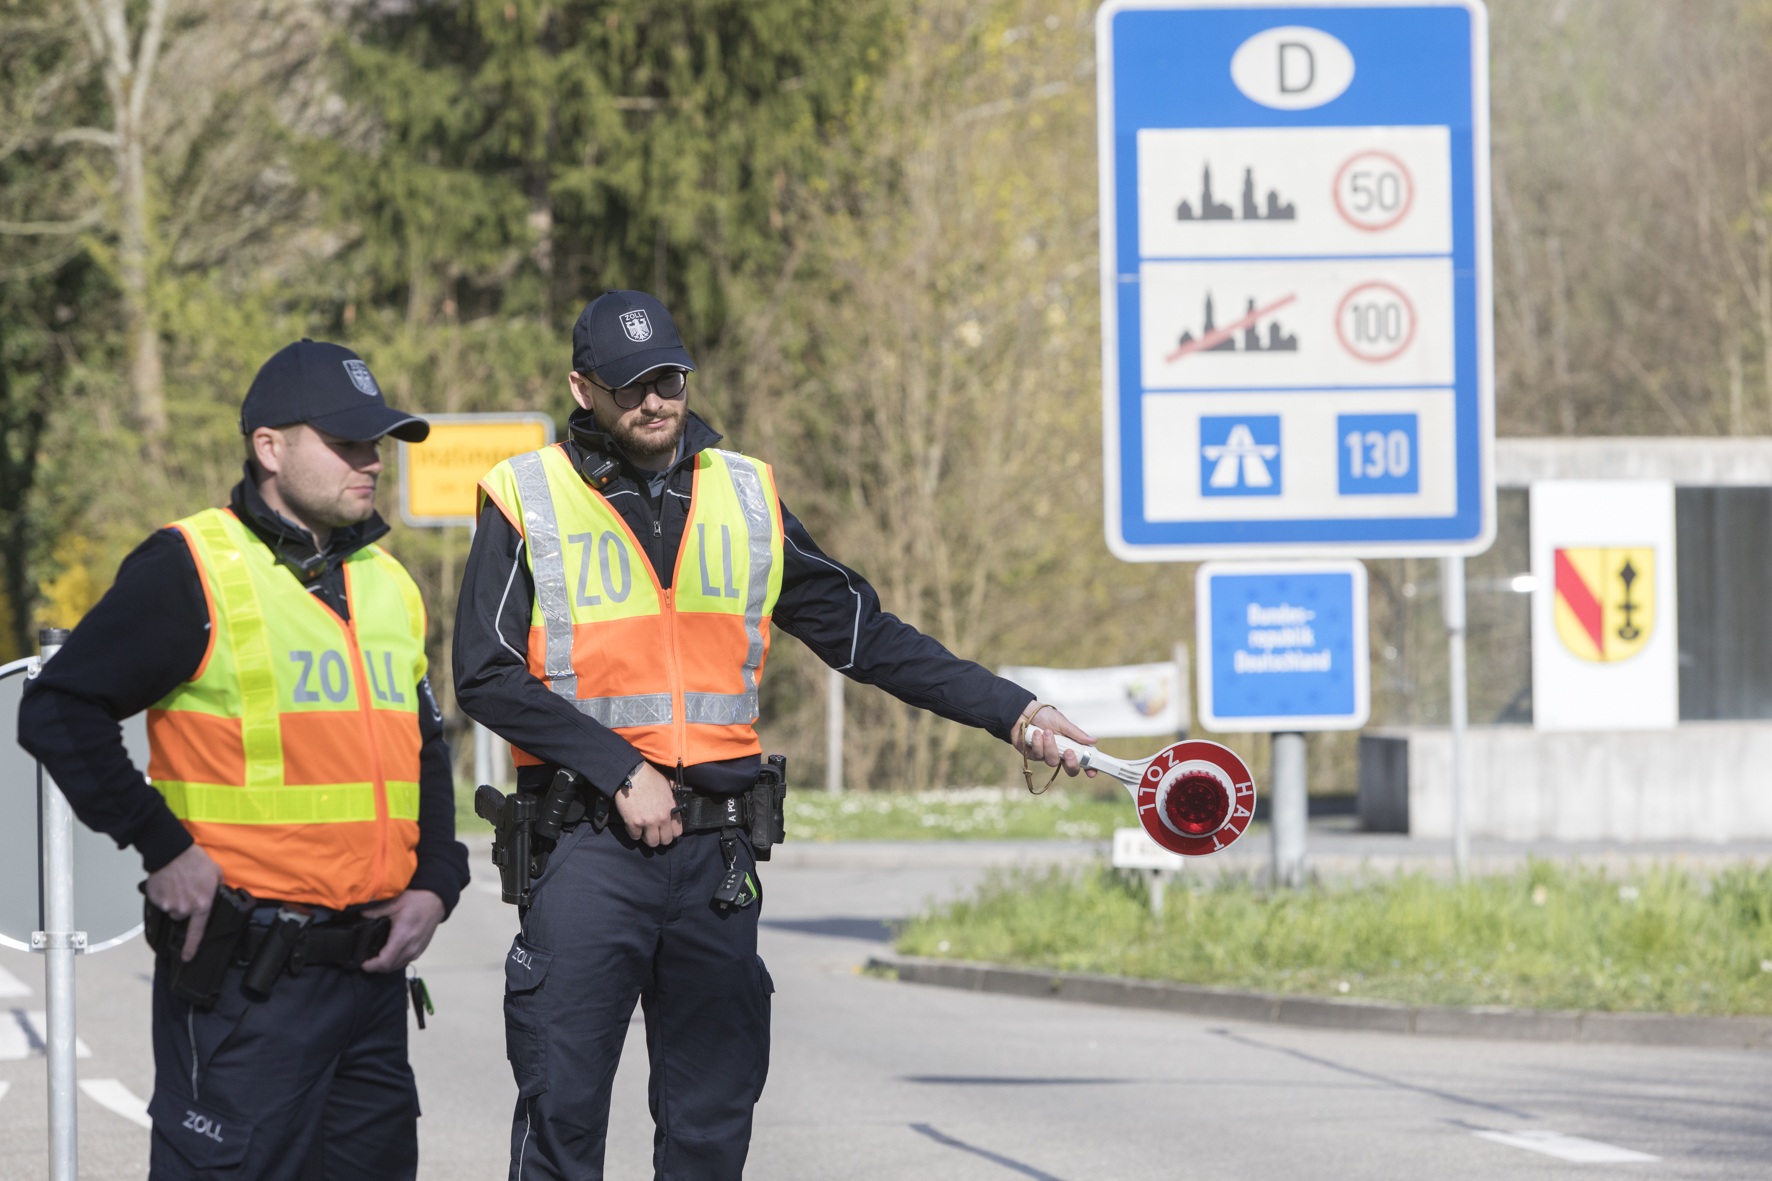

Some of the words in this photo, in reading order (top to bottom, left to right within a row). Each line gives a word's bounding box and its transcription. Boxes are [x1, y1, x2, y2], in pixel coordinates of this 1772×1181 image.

[1278, 41, 1316, 94] D
[1350, 170, 1401, 214] 50
[624, 311, 644, 321] ZOLL
[1352, 302, 1401, 344] 100
[1344, 429, 1411, 479] 130
[1139, 749, 1180, 815] ZOLL
[1211, 781, 1253, 851] HALT
[511, 946, 533, 970] ZOLL
[182, 1109, 224, 1143] ZOLL
